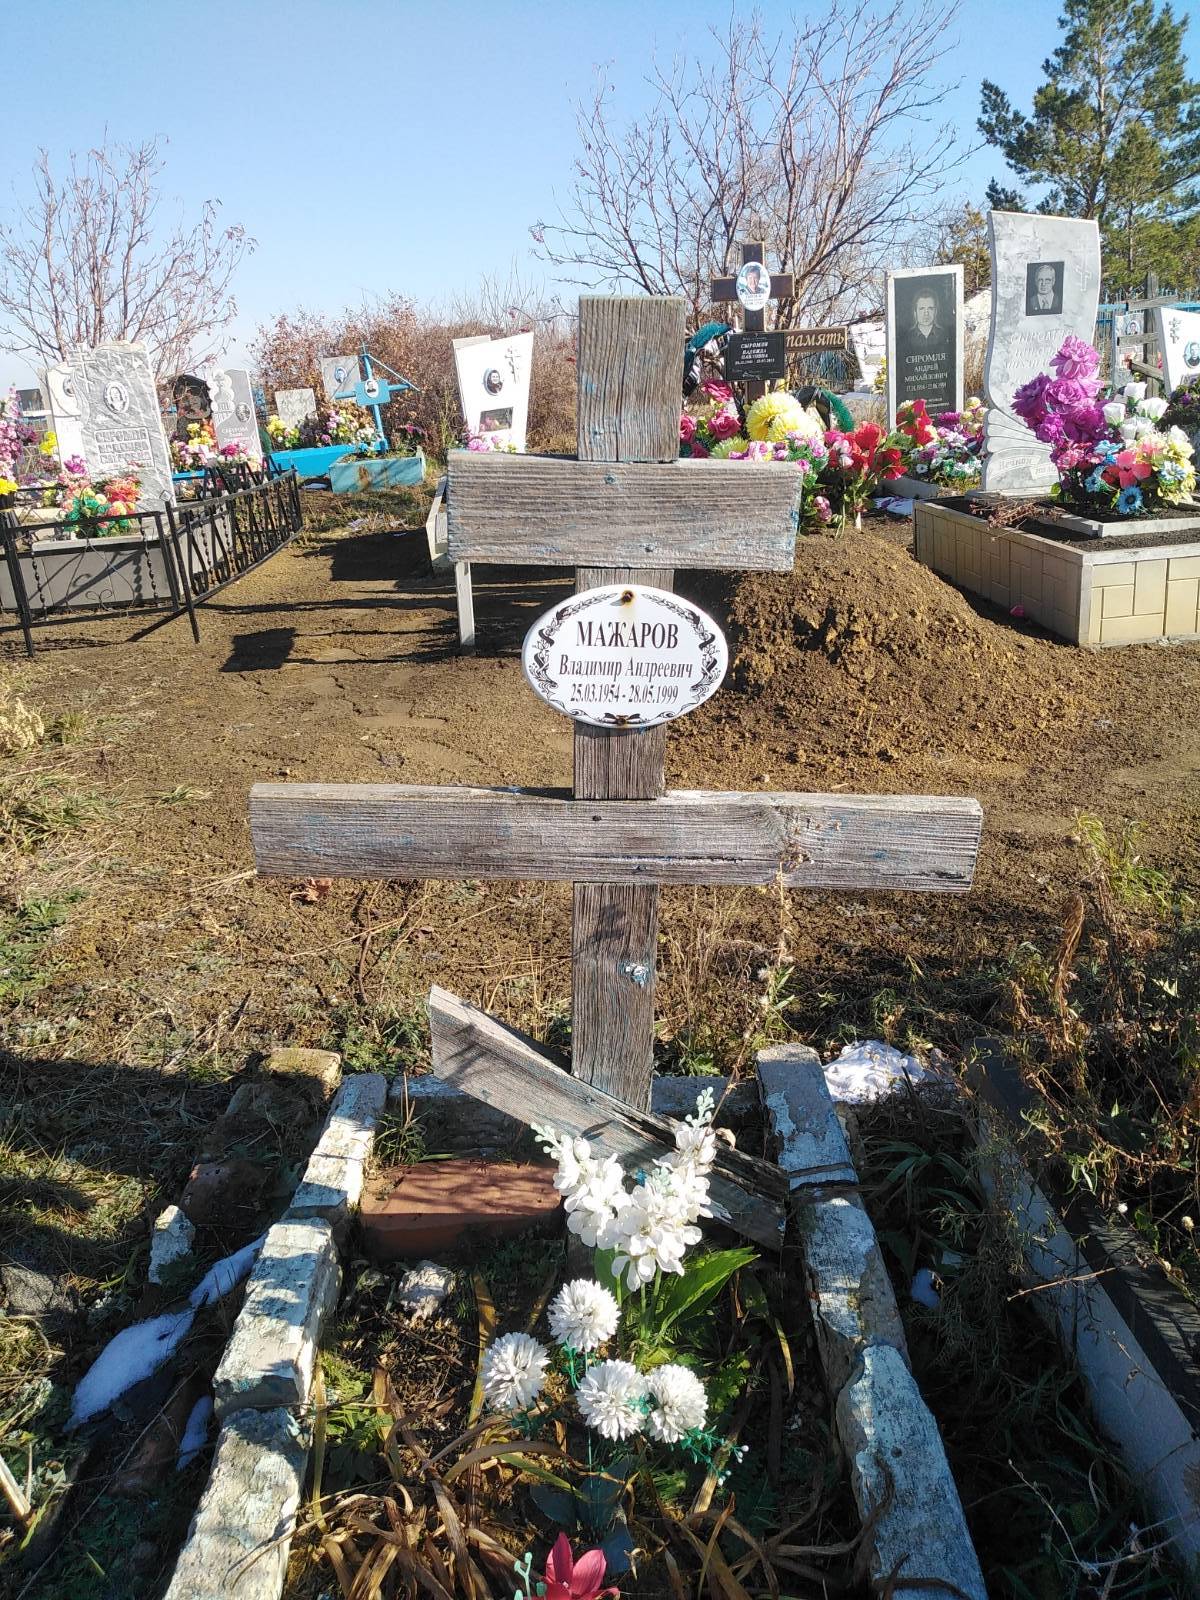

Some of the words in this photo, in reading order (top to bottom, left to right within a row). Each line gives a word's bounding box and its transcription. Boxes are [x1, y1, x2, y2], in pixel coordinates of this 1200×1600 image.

[785, 332, 845, 348] память
[576, 620, 679, 649] МАЖАРОВ
[559, 654, 622, 681] Владимир
[625, 656, 693, 682] Андреевич
[570, 683, 620, 703] 25.03.1954
[629, 684, 679, 705] 28.05.1999
